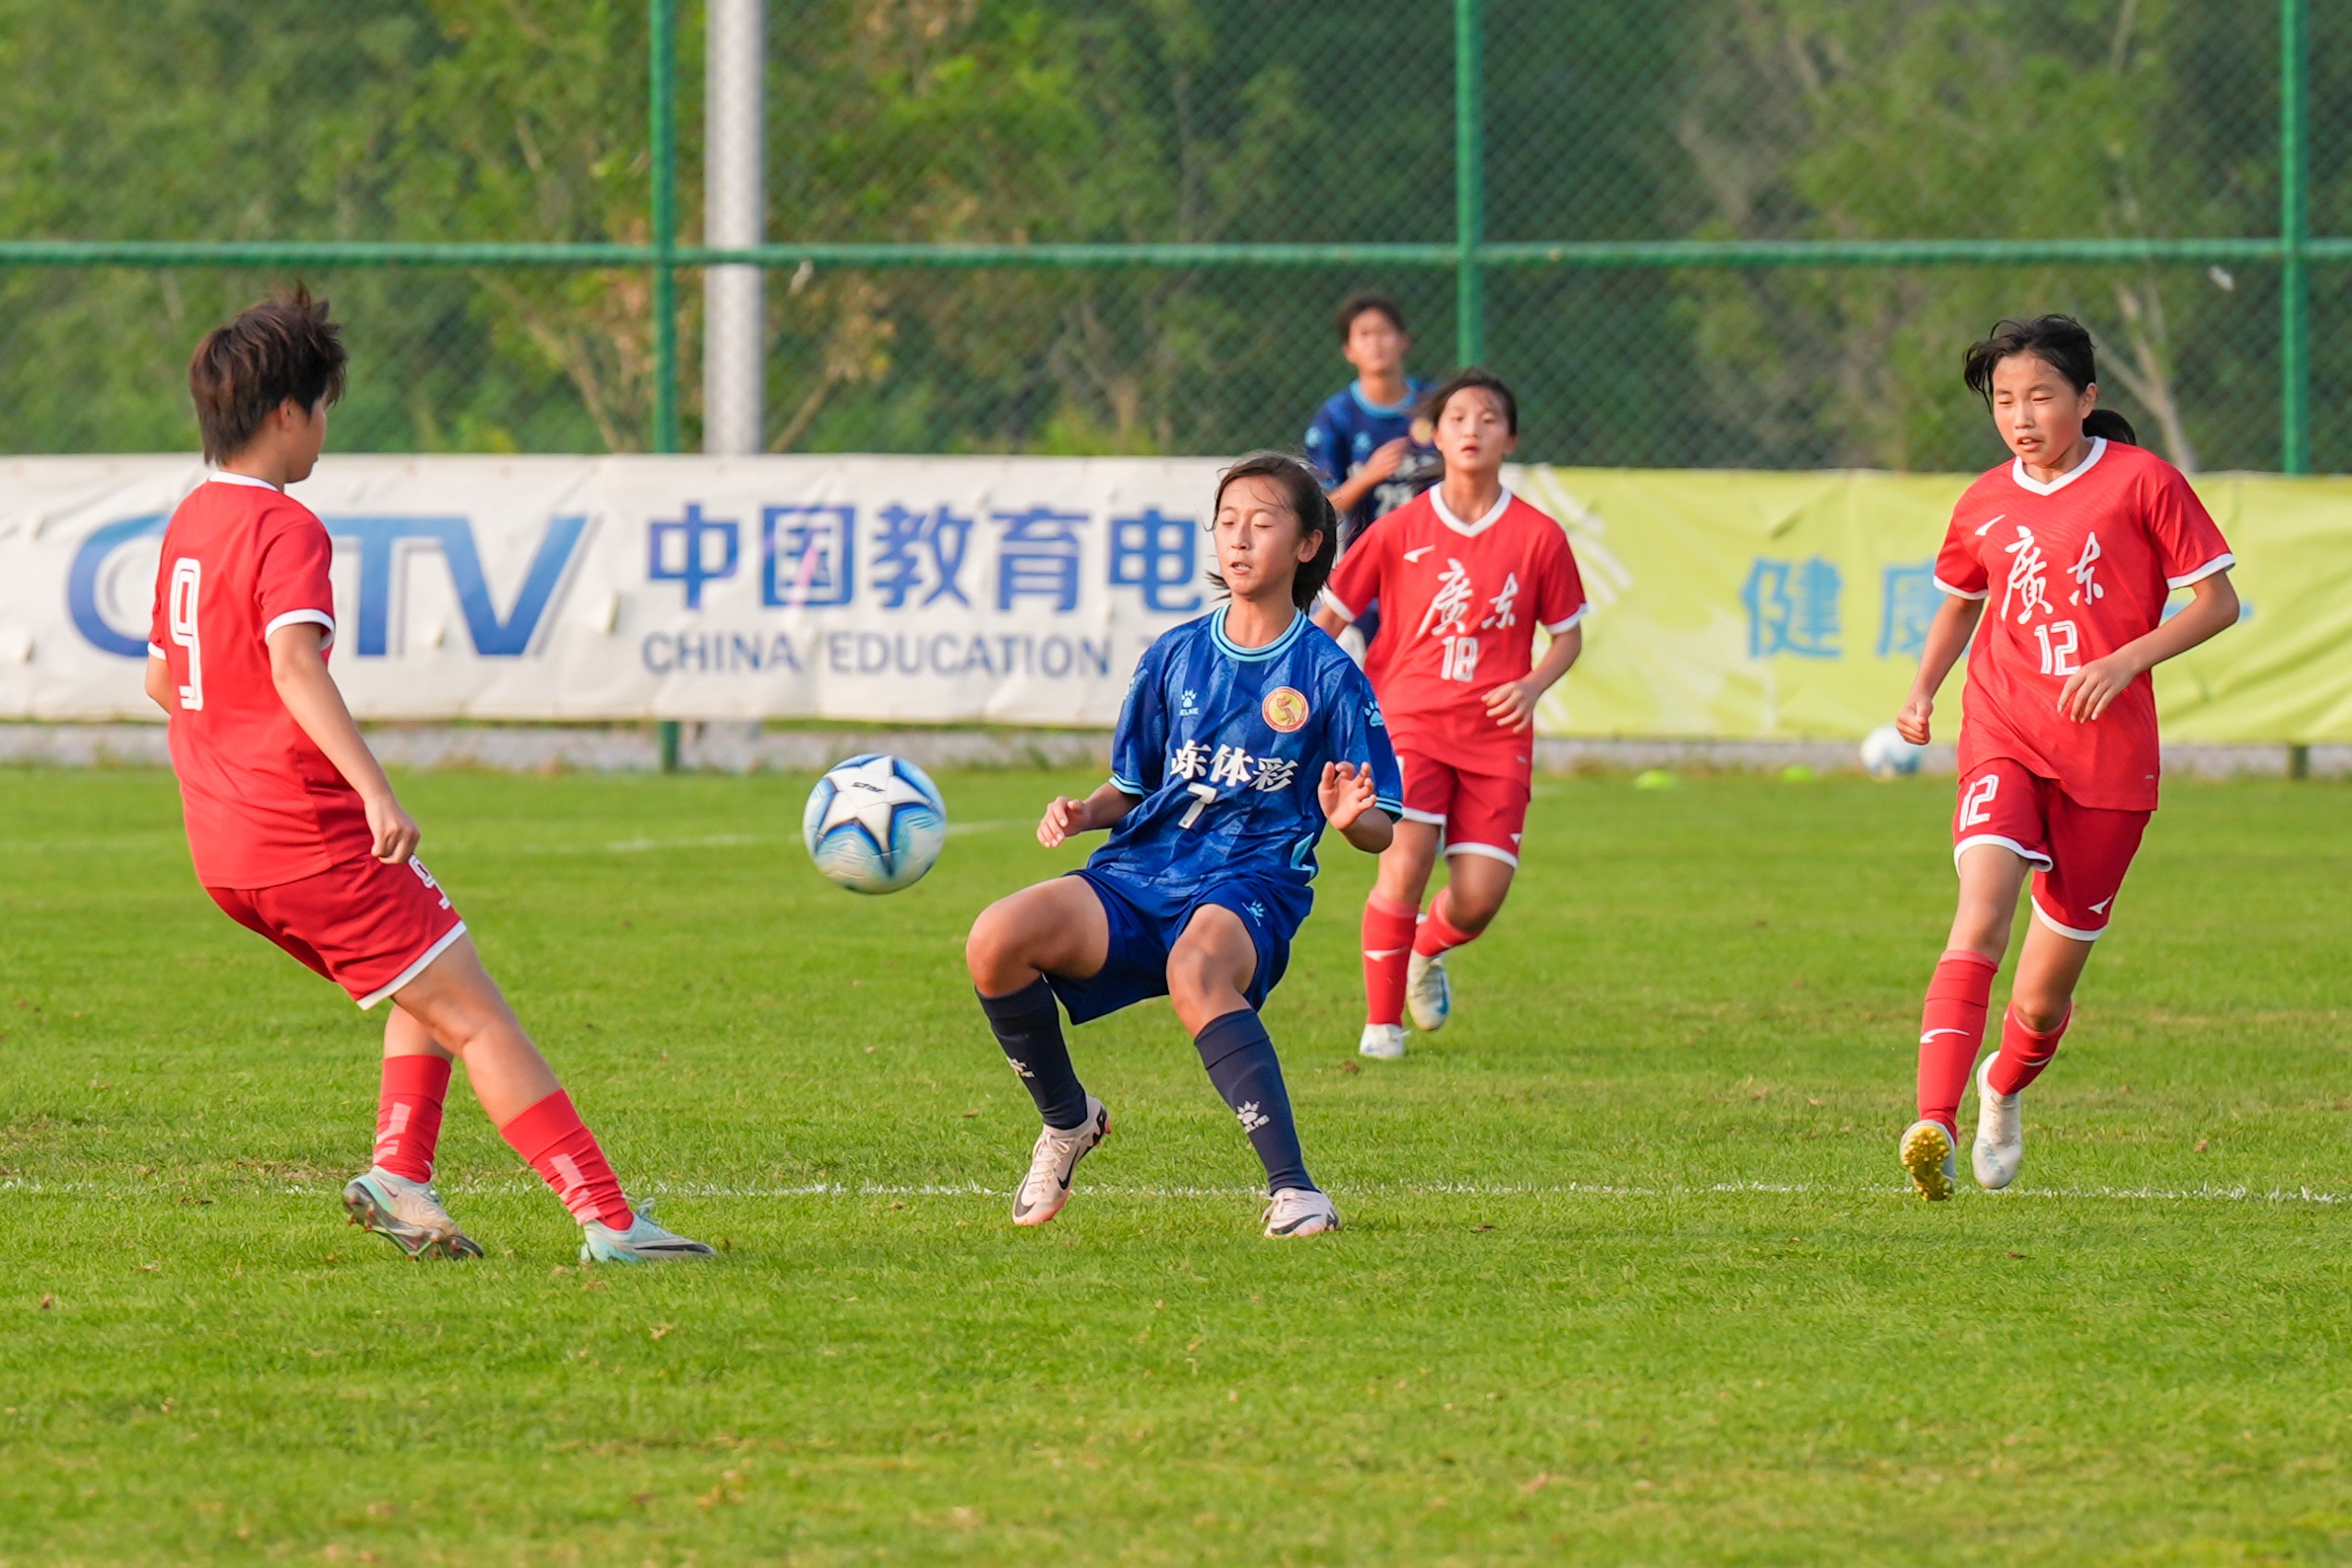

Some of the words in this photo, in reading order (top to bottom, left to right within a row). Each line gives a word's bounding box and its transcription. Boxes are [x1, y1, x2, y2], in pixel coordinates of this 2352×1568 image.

[66, 512, 589, 658] CTV
[648, 504, 1204, 612] 中国教育电
[169, 557, 203, 711] 9
[642, 631, 803, 676] CHINA
[827, 631, 1112, 676] EDUCATION
[1441, 635, 1478, 683] 18
[2034, 620, 2081, 676] 12
[1178, 781, 1217, 829] 7
[1959, 774, 1999, 832] 12
